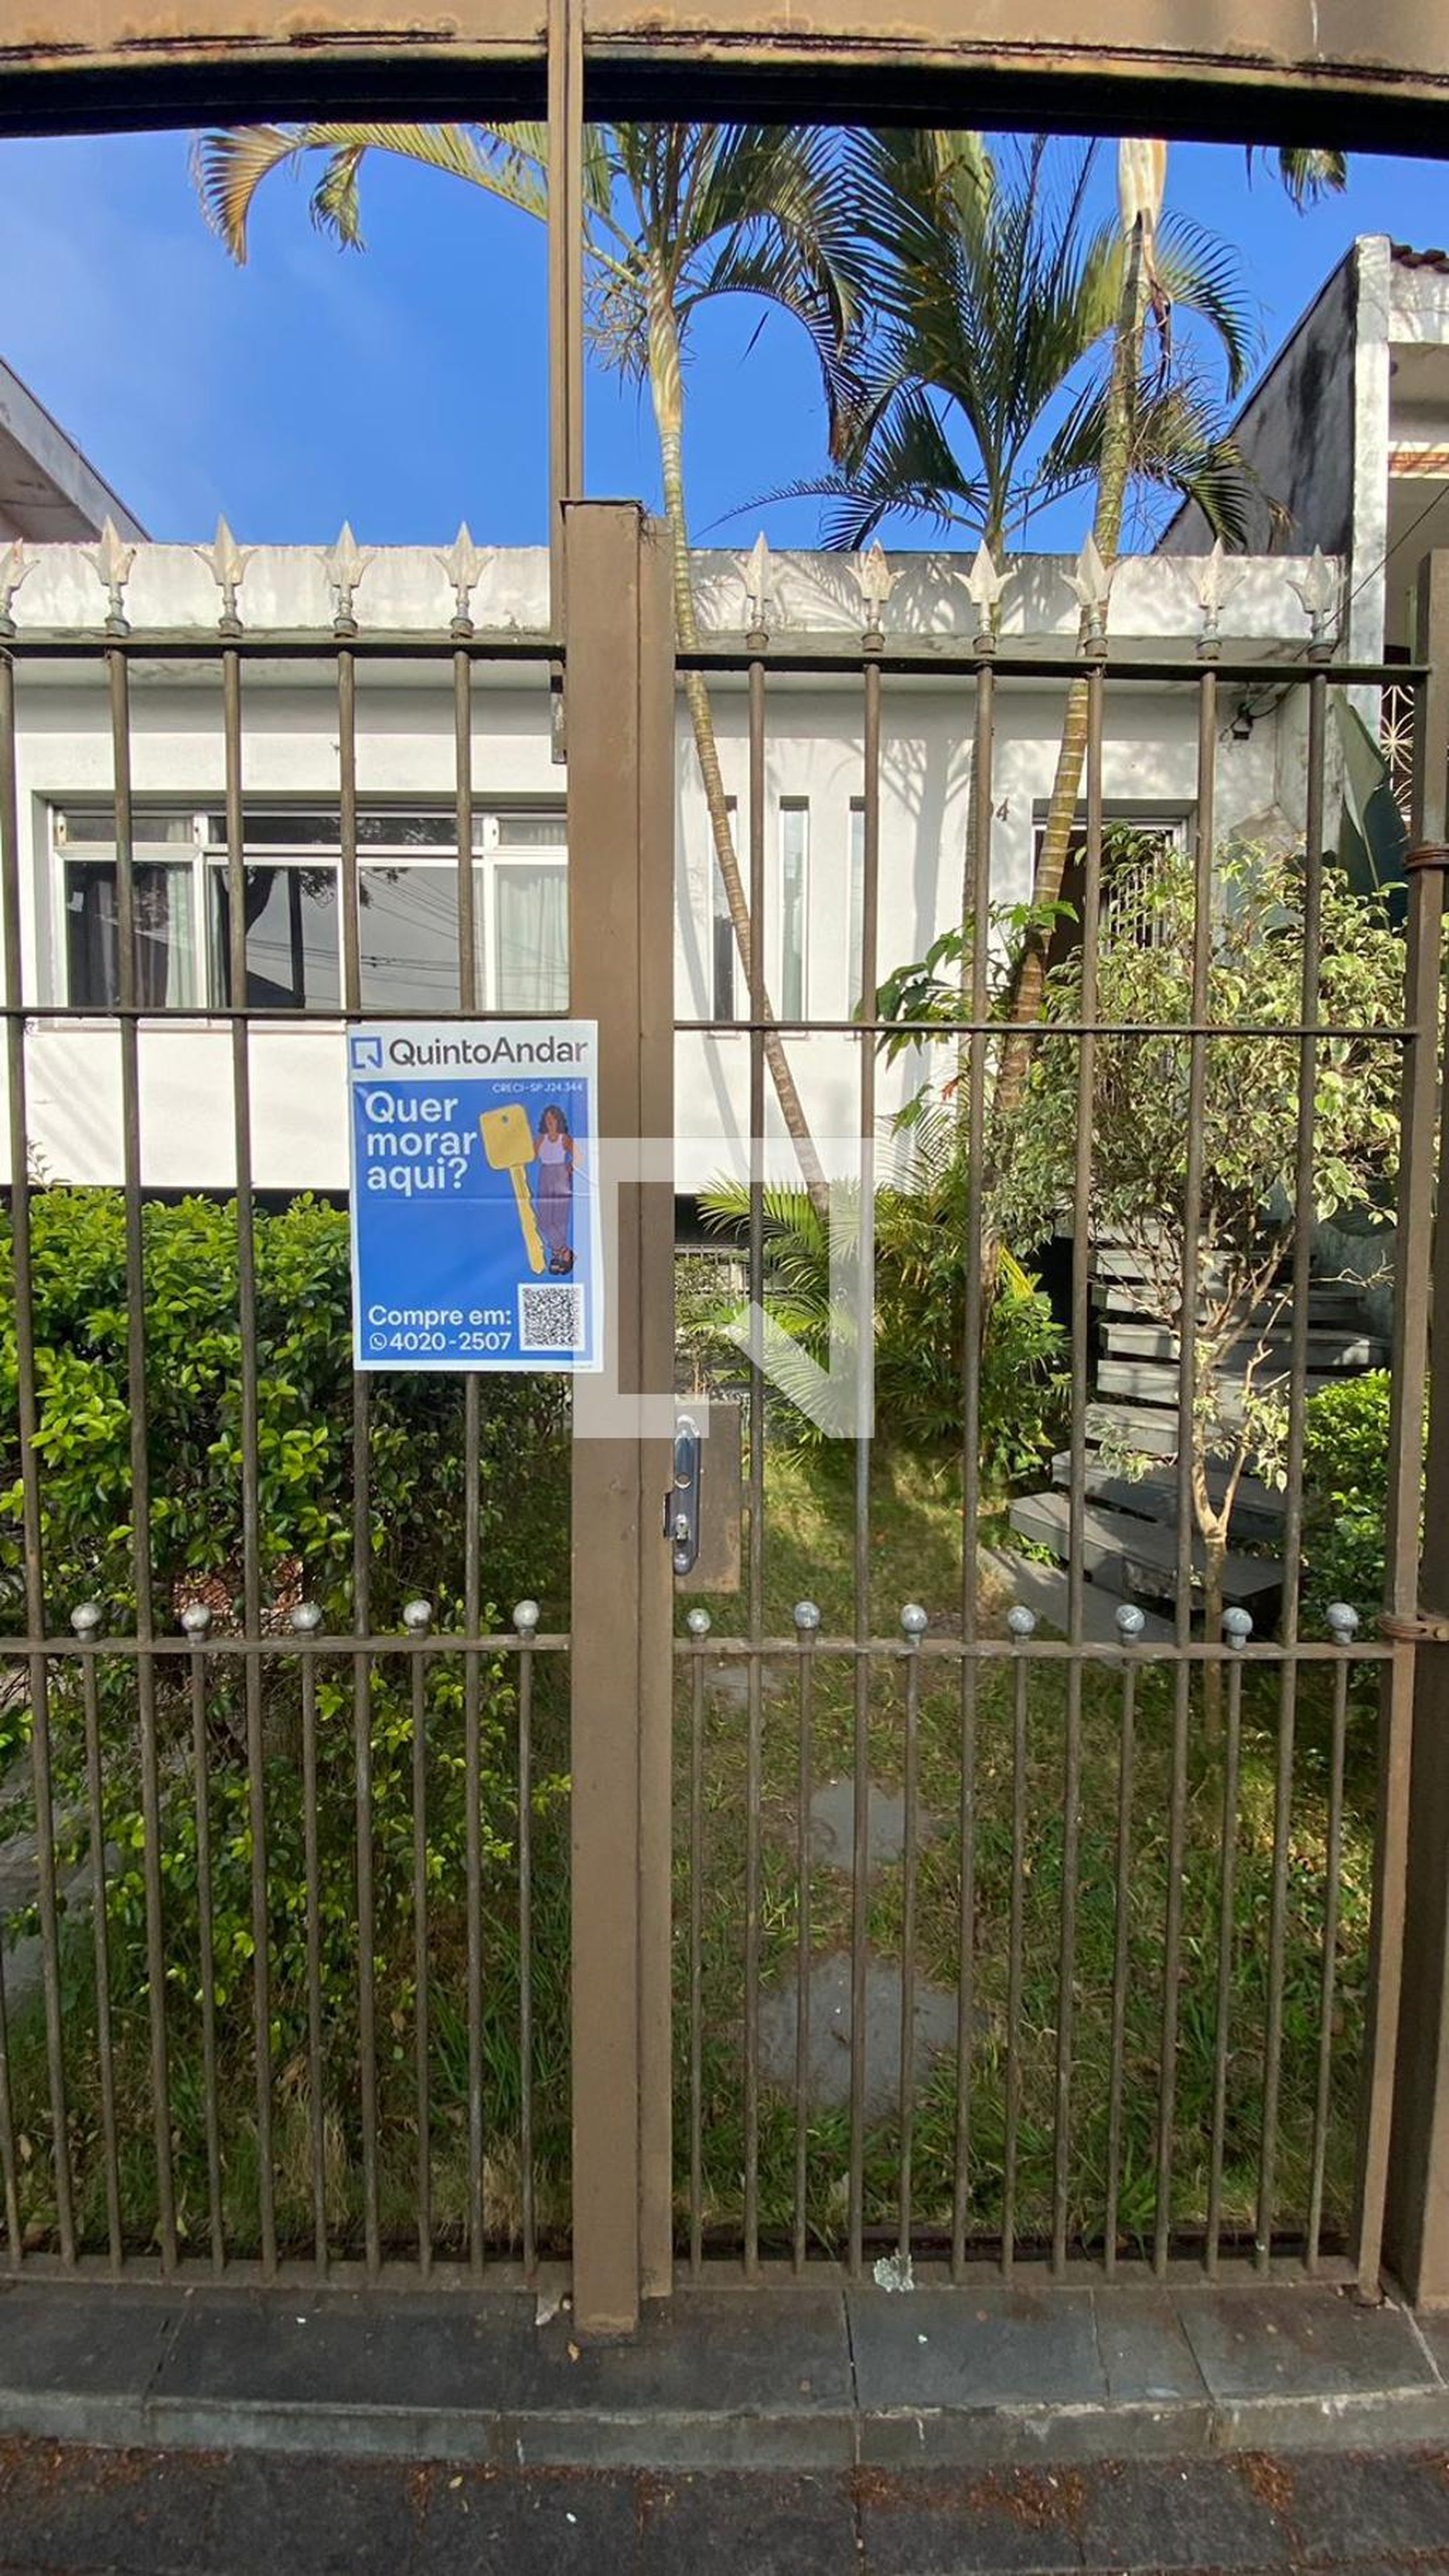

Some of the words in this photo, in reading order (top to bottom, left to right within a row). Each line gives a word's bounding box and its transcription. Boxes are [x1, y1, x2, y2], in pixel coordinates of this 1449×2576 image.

[389, 1036, 588, 1066] QuintoAndar
[365, 1091, 458, 1123] Quer
[367, 1132, 477, 1156] morar
[367, 1157, 468, 1197] aqui?
[369, 1305, 463, 1330] Compre
[469, 1309, 511, 1325] em:
